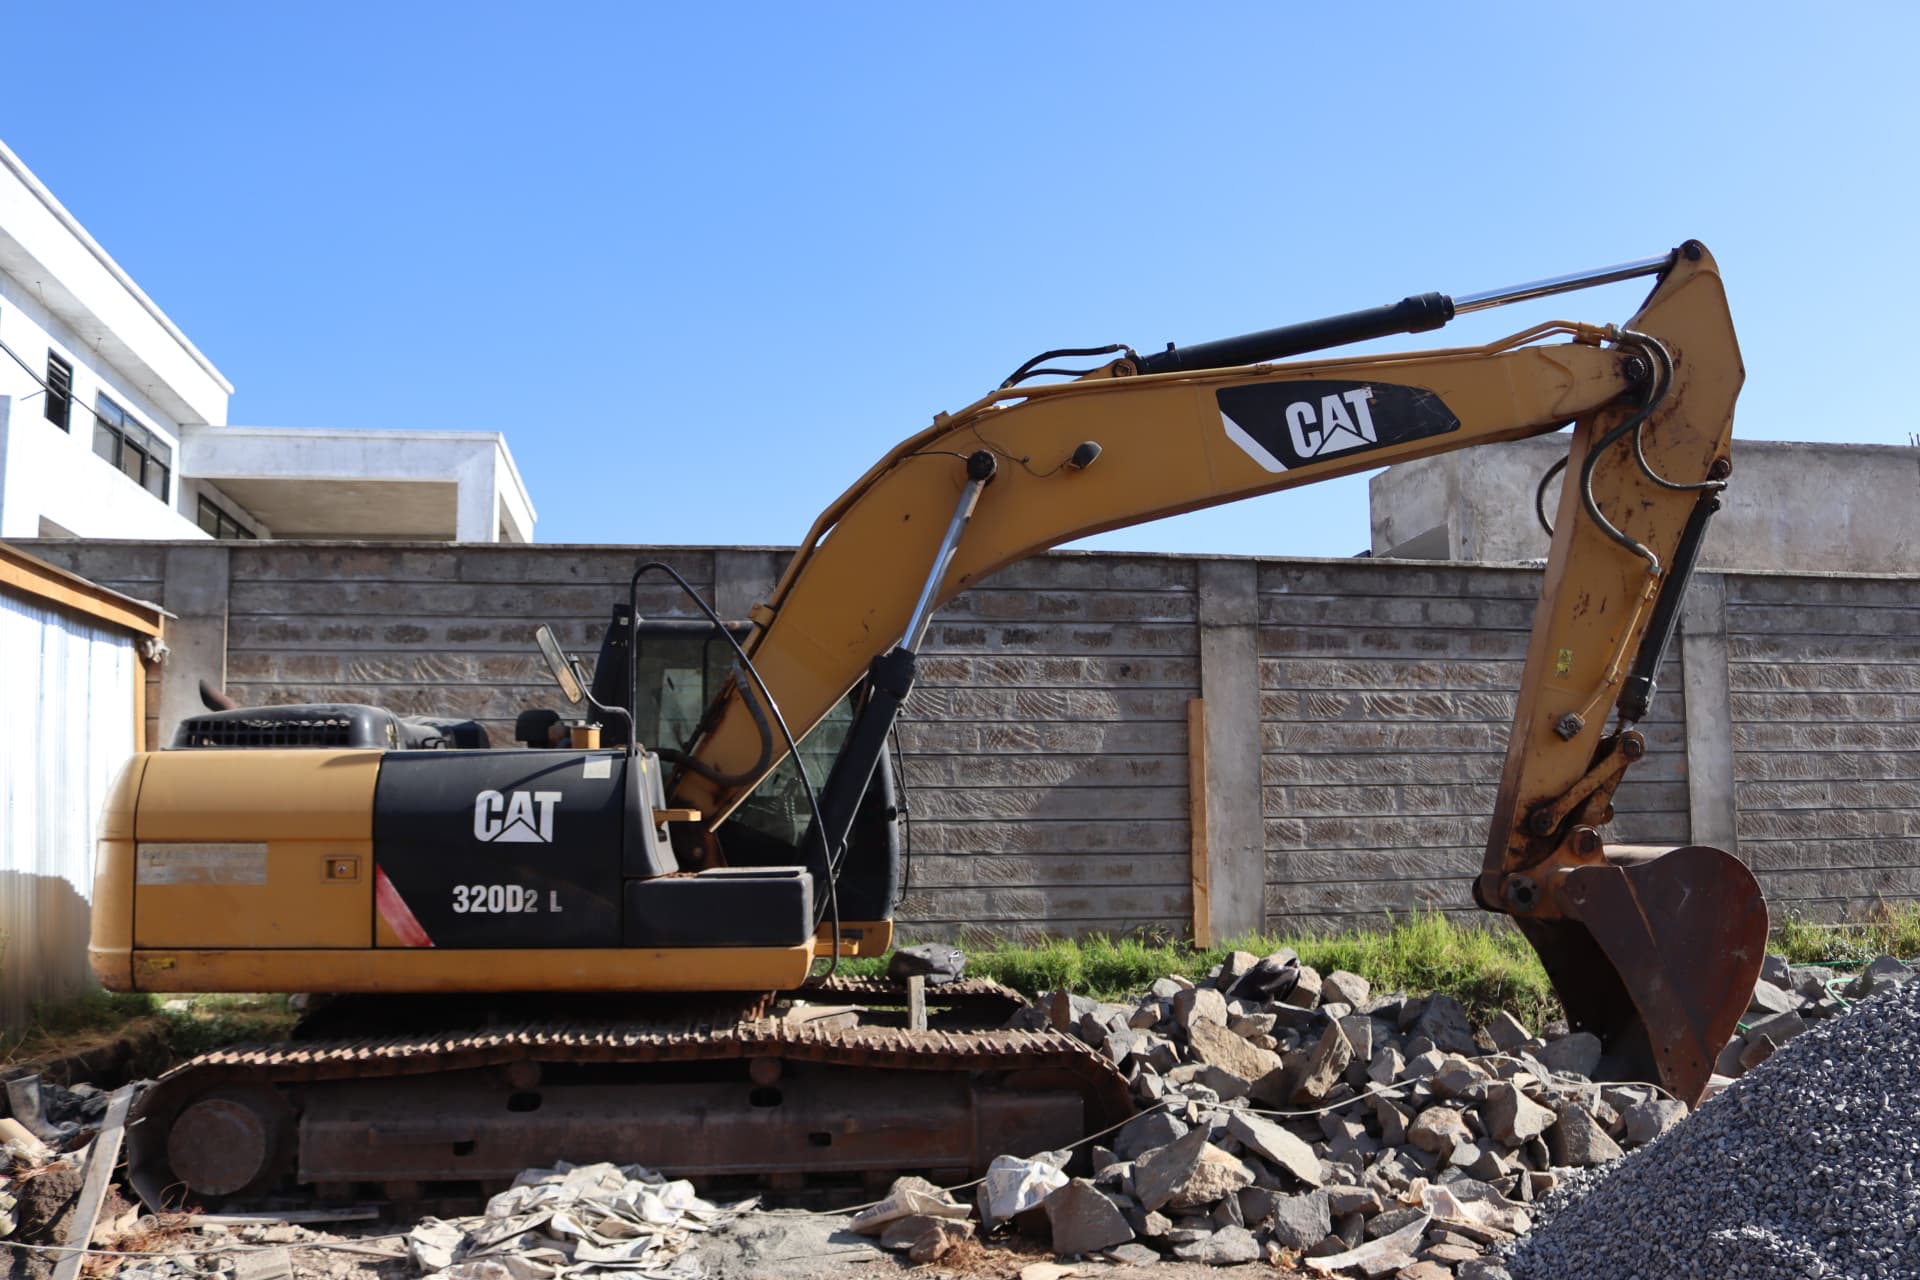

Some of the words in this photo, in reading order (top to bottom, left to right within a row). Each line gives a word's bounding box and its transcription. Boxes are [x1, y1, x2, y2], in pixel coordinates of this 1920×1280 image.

[1285, 386, 1378, 458] CAT
[473, 789, 563, 843] CAT
[452, 884, 539, 914] 320D2
[549, 890, 563, 913] L
